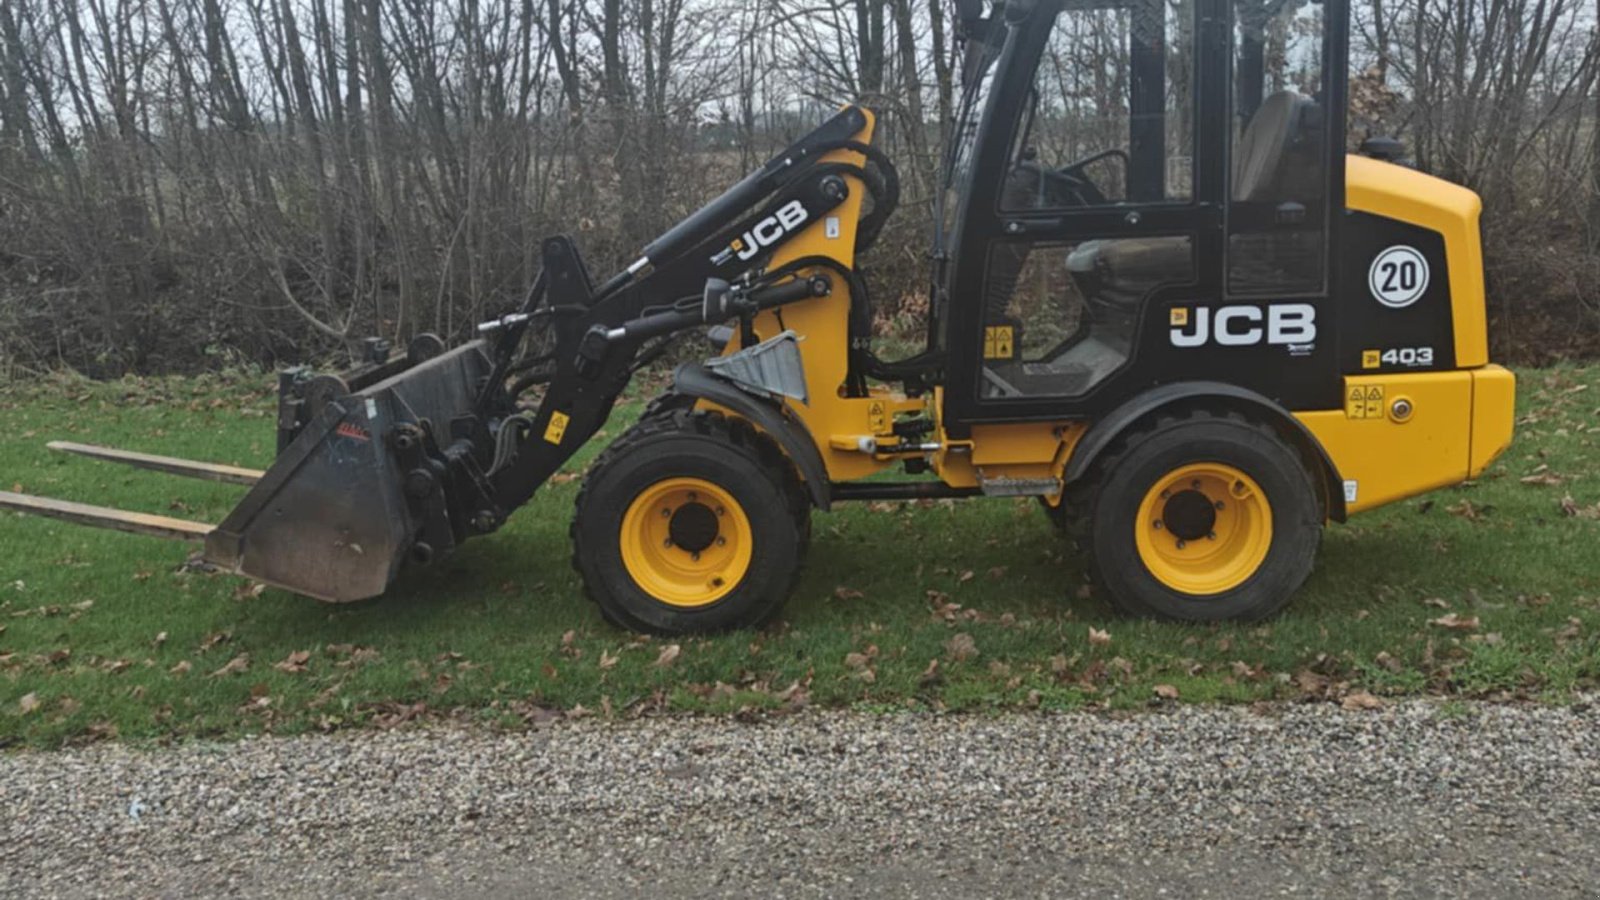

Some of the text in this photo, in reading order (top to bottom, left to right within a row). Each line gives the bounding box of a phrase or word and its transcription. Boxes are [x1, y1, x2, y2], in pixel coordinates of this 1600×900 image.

[737, 200, 808, 261] JCB
[1381, 260, 1417, 293] 20
[1170, 303, 1317, 347] JCB
[1381, 347, 1434, 365] 403
